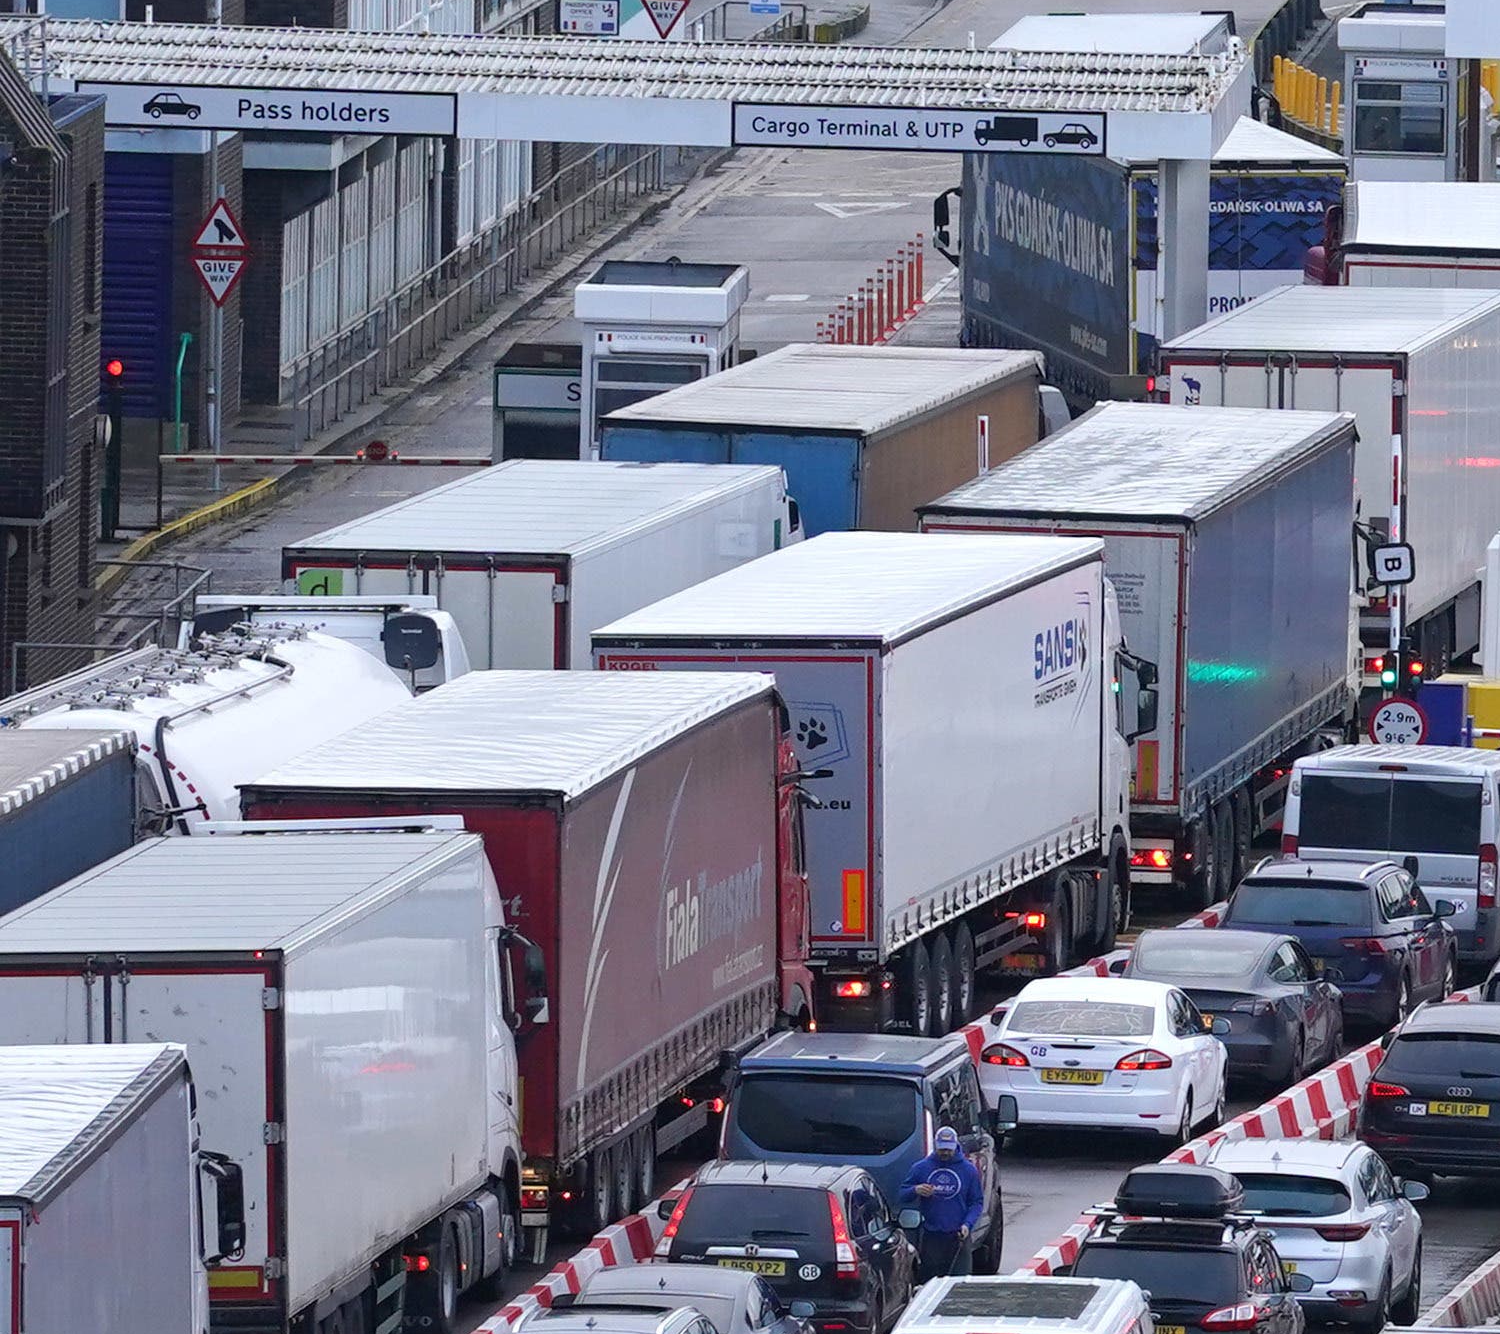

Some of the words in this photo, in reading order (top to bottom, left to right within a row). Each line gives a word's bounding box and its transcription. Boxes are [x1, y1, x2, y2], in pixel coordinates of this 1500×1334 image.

[565, 1, 599, 10] PASSPORT
[650, 2, 679, 12] GIVE
[656, 11, 674, 20] WAY
[238, 98, 293, 121] Pass
[301, 100, 390, 124] holders
[752, 116, 810, 138] Cargo
[817, 118, 898, 138] Terminal
[904, 122, 919, 138] &
[924, 122, 964, 140] UTP
[202, 262, 236, 273] GIVE
[210, 273, 232, 283] WAY
[1384, 556, 1402, 572] B
[1383, 710, 1416, 724] 2.9m
[1030, 1045, 1047, 1057] GB
[801, 1266, 818, 1279] GB
